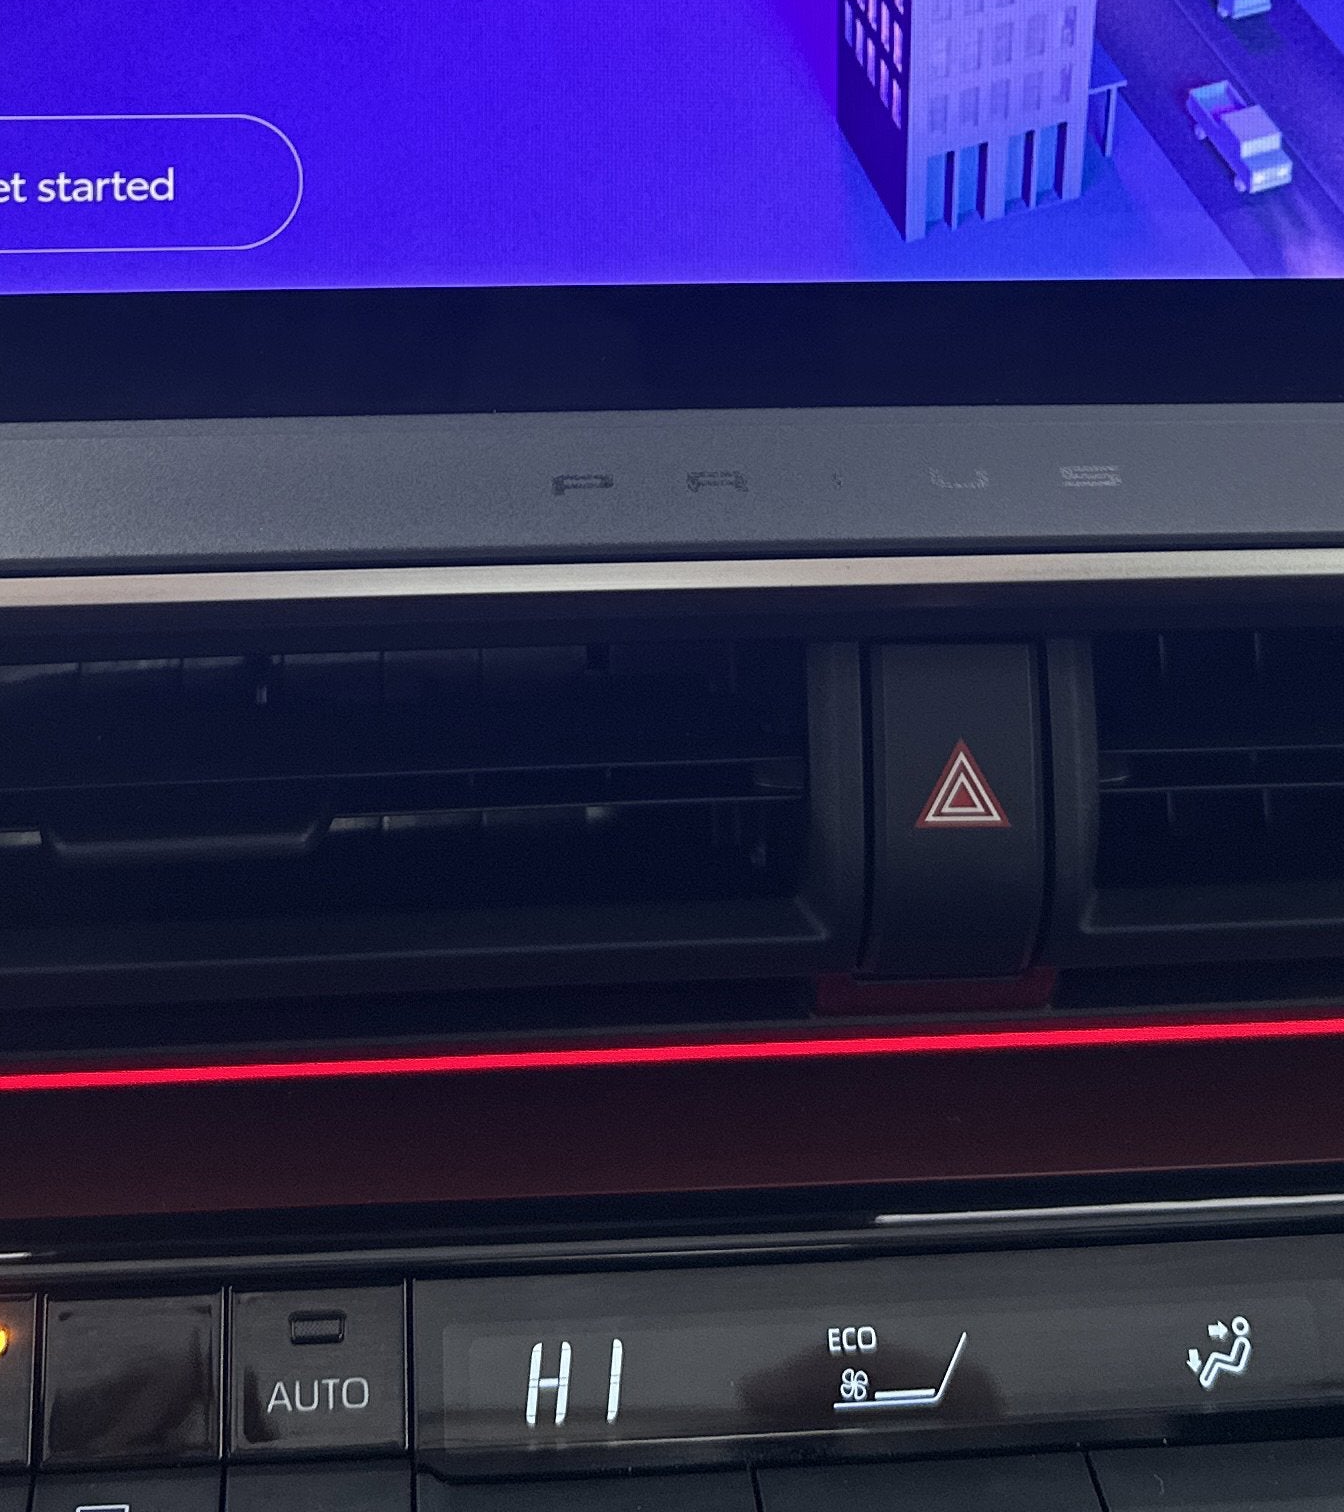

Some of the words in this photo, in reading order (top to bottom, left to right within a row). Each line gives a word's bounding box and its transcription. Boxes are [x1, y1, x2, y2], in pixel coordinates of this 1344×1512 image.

[37, 166, 176, 204] started
[827, 1326, 877, 1354] ECO
[266, 1376, 370, 1414] AUTO
[525, 1337, 624, 1427] HI
